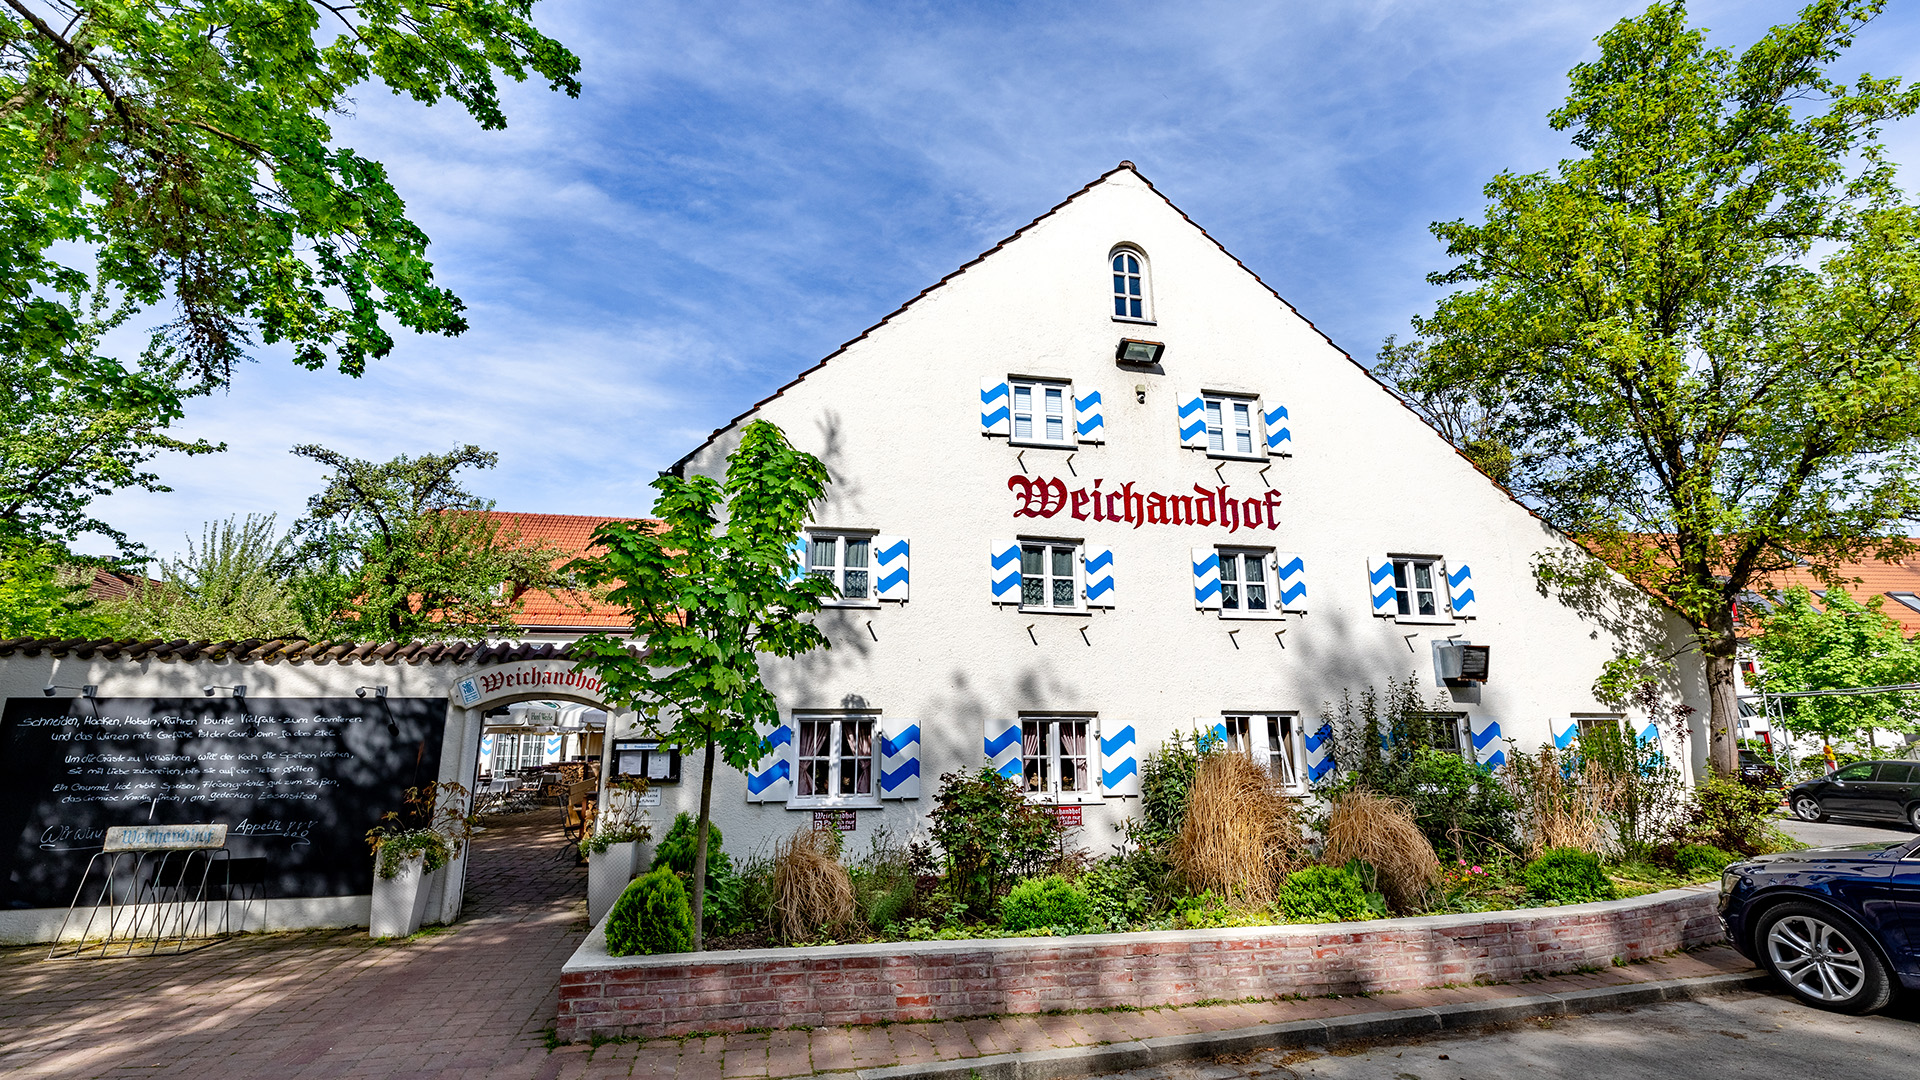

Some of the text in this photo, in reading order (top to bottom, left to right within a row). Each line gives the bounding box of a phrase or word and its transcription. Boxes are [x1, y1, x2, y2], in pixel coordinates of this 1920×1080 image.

[1008, 474, 1282, 533] Weichandhof
[204, 716, 235, 724] bunte
[240, 714, 276, 726] Vielfalt
[51, 732, 72, 741] und
[74, 732, 93, 740] das
[132, 732, 152, 740] mit
[220, 752, 234, 760] der
[262, 752, 276, 760] die
[235, 818, 282, 835] Appetit
